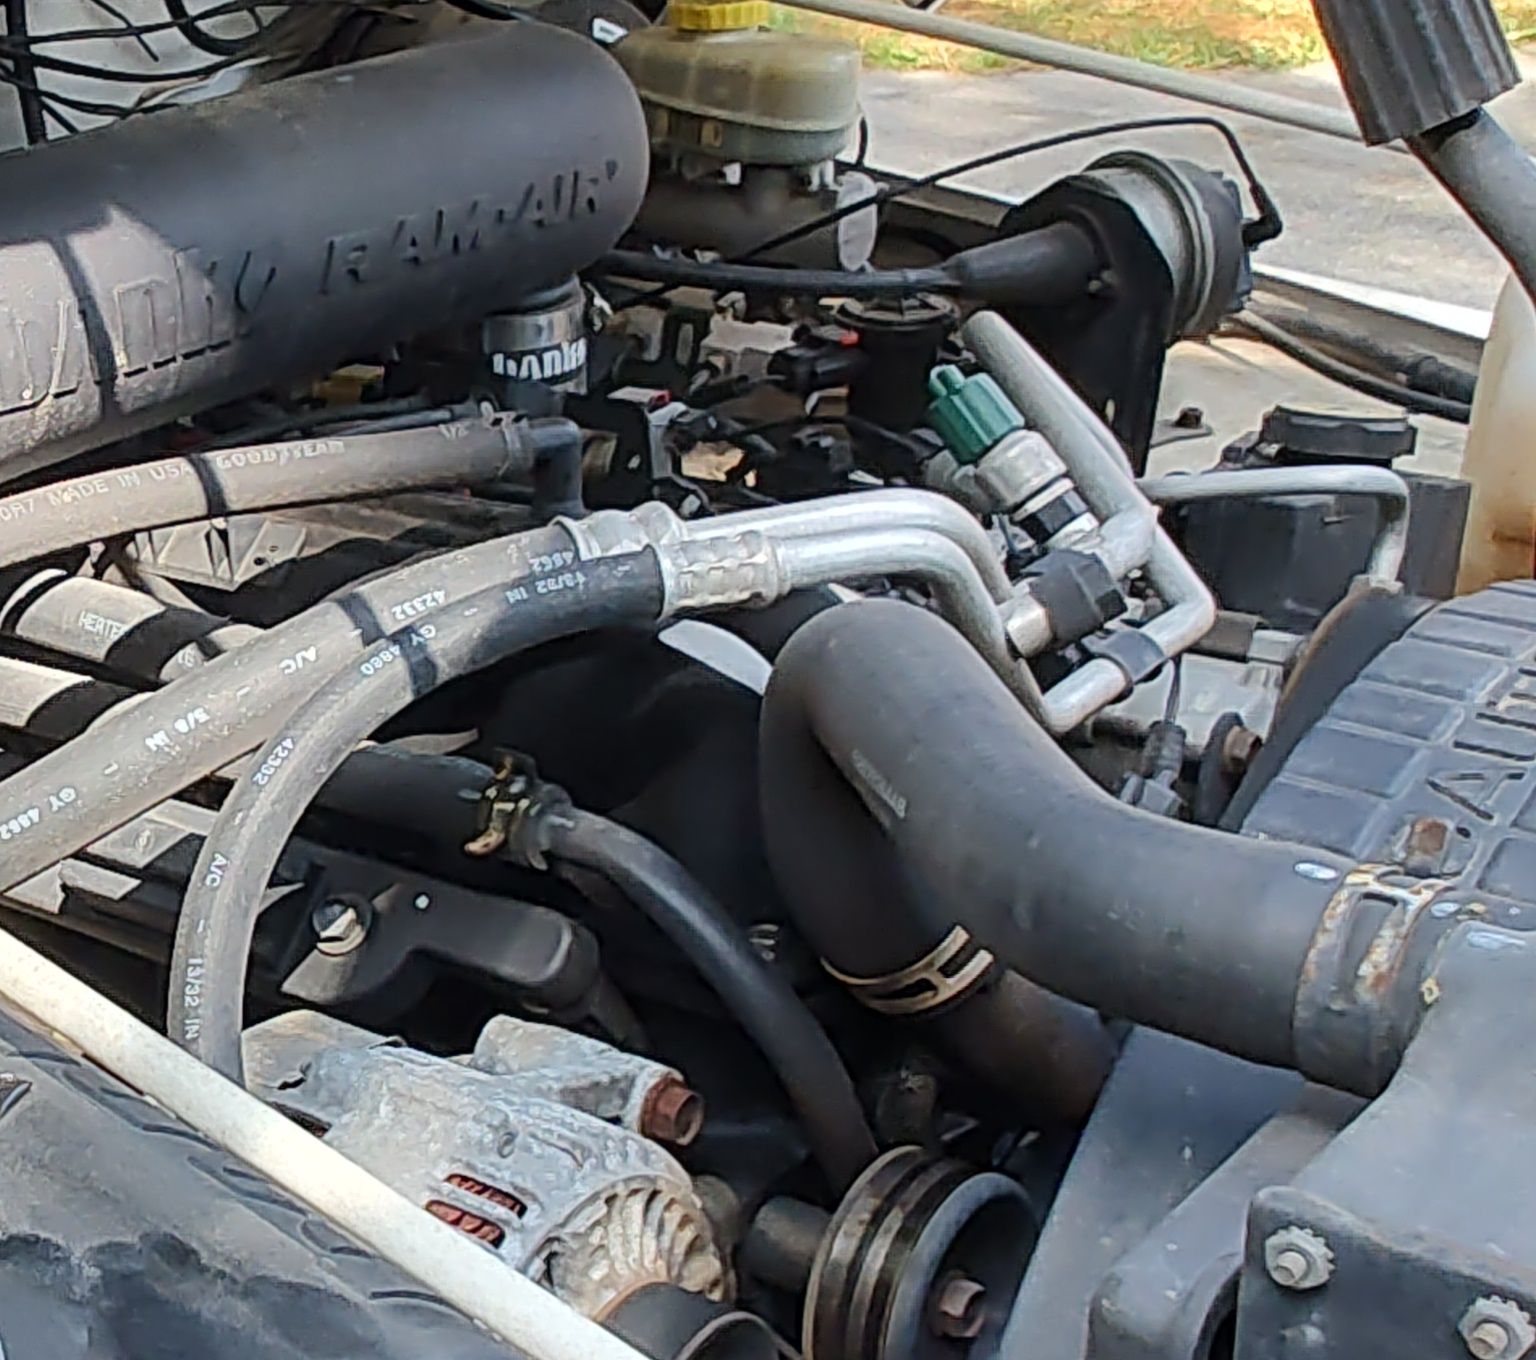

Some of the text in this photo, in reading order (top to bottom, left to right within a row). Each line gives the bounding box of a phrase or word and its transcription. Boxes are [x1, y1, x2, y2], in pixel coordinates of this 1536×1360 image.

[215, 439, 344, 469] GOODYEAR
[47, 476, 109, 507] MADE
[116, 471, 141, 488] IN
[149, 458, 193, 481] USA
[391, 589, 447, 620] 42332
[410, 623, 437, 647] GY
[279, 645, 318, 675] A/C
[46, 784, 78, 812] GY
[204, 852, 230, 889] A/C
[183, 957, 203, 1008] 13/32
[184, 1018, 200, 1041] IN
